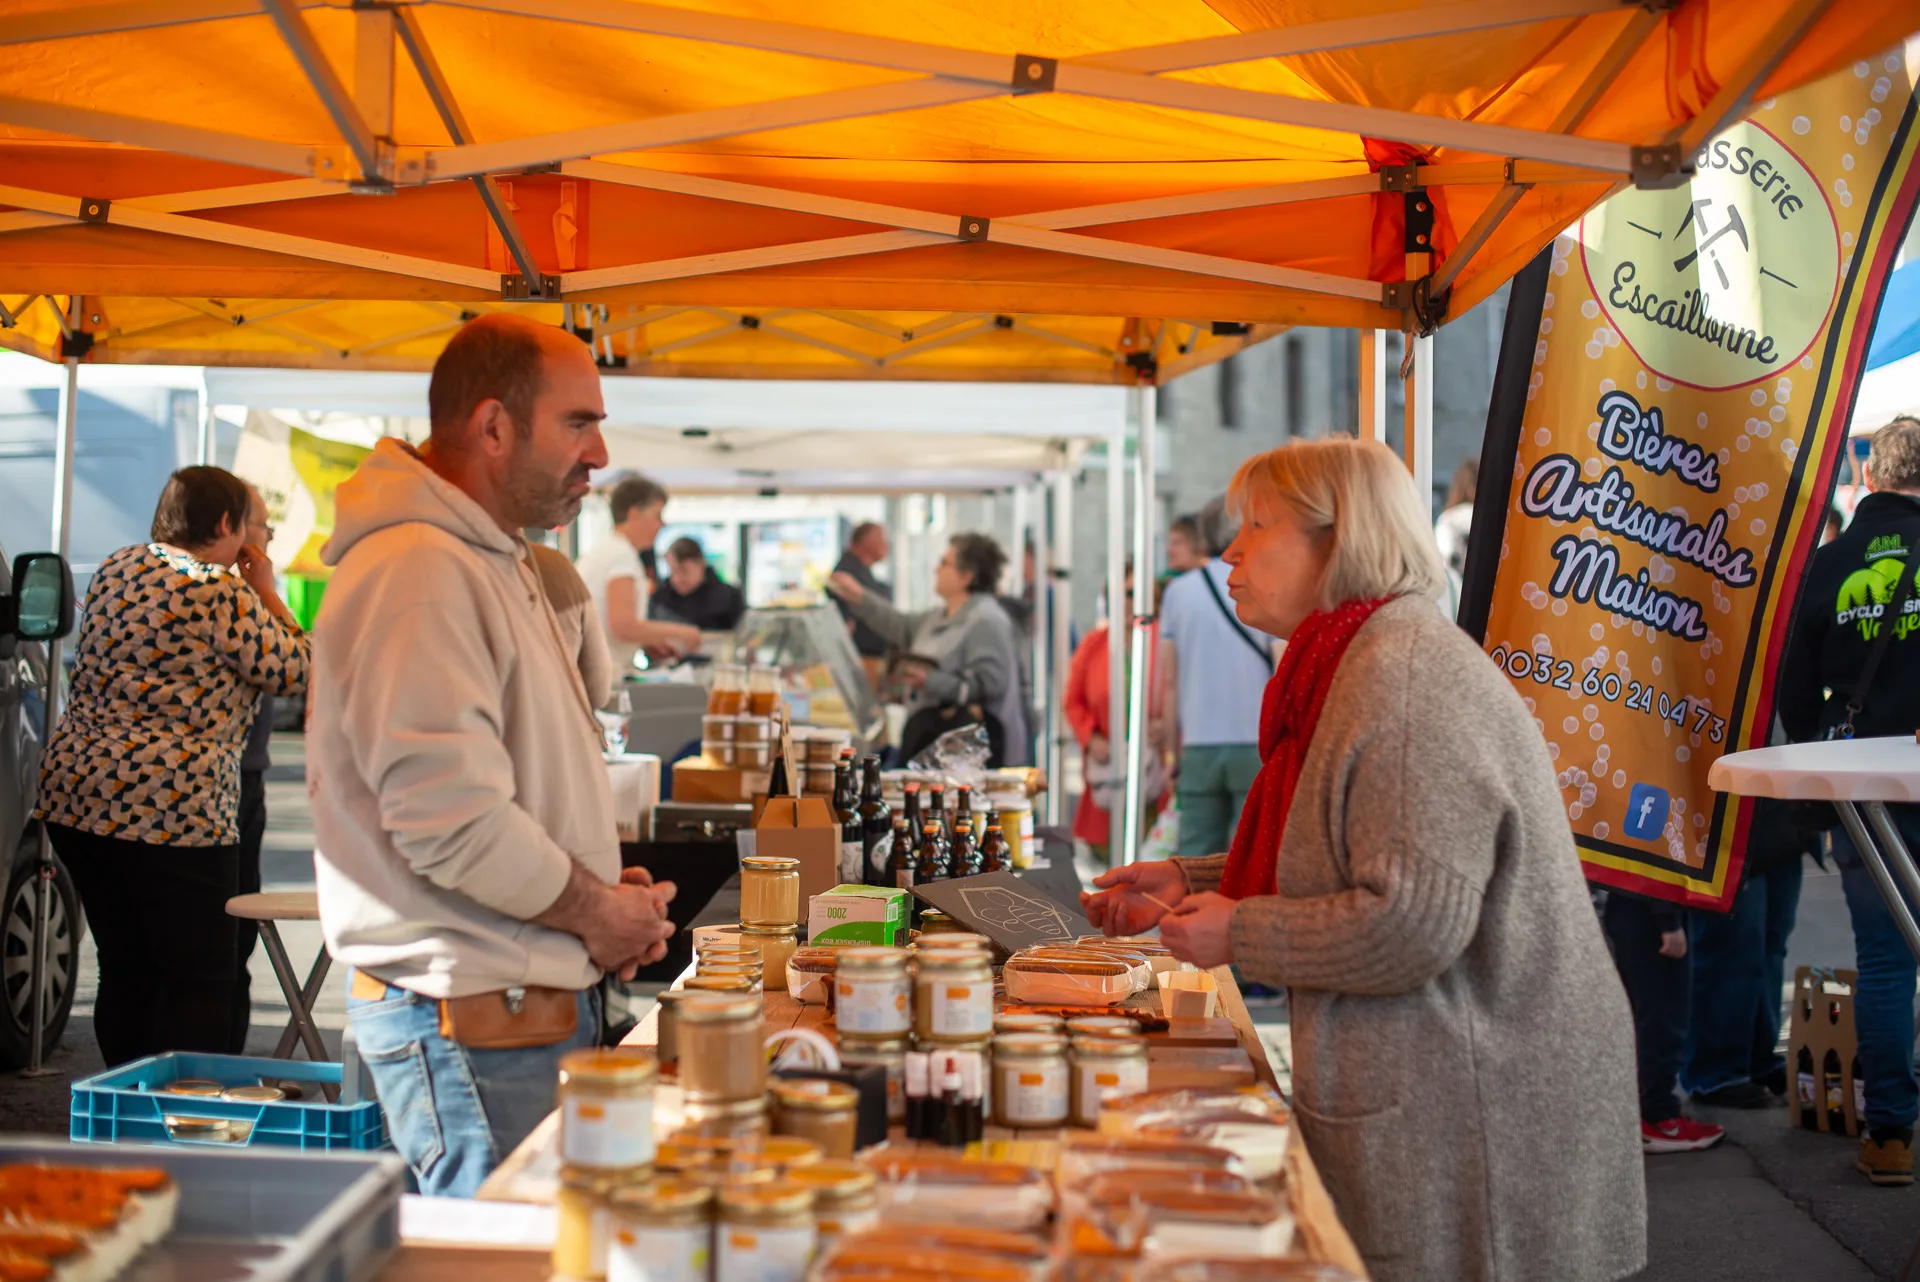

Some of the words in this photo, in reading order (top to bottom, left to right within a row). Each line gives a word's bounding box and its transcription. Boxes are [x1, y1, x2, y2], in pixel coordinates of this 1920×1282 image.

[1696, 140, 1804, 220] asserie
[1609, 261, 1779, 364] Escaillonne
[1599, 393, 1719, 491] Bières
[1522, 455, 1756, 587] Artisanales
[1550, 536, 1707, 640] Maison
[1490, 646, 1574, 690] 0032
[1582, 668, 1621, 701] 60
[1625, 681, 1653, 714] 24
[1658, 692, 1688, 727] 04
[1692, 702, 1725, 743] 73
[827, 907, 847, 919] 2000
[835, 939, 871, 947] DISPENSER
